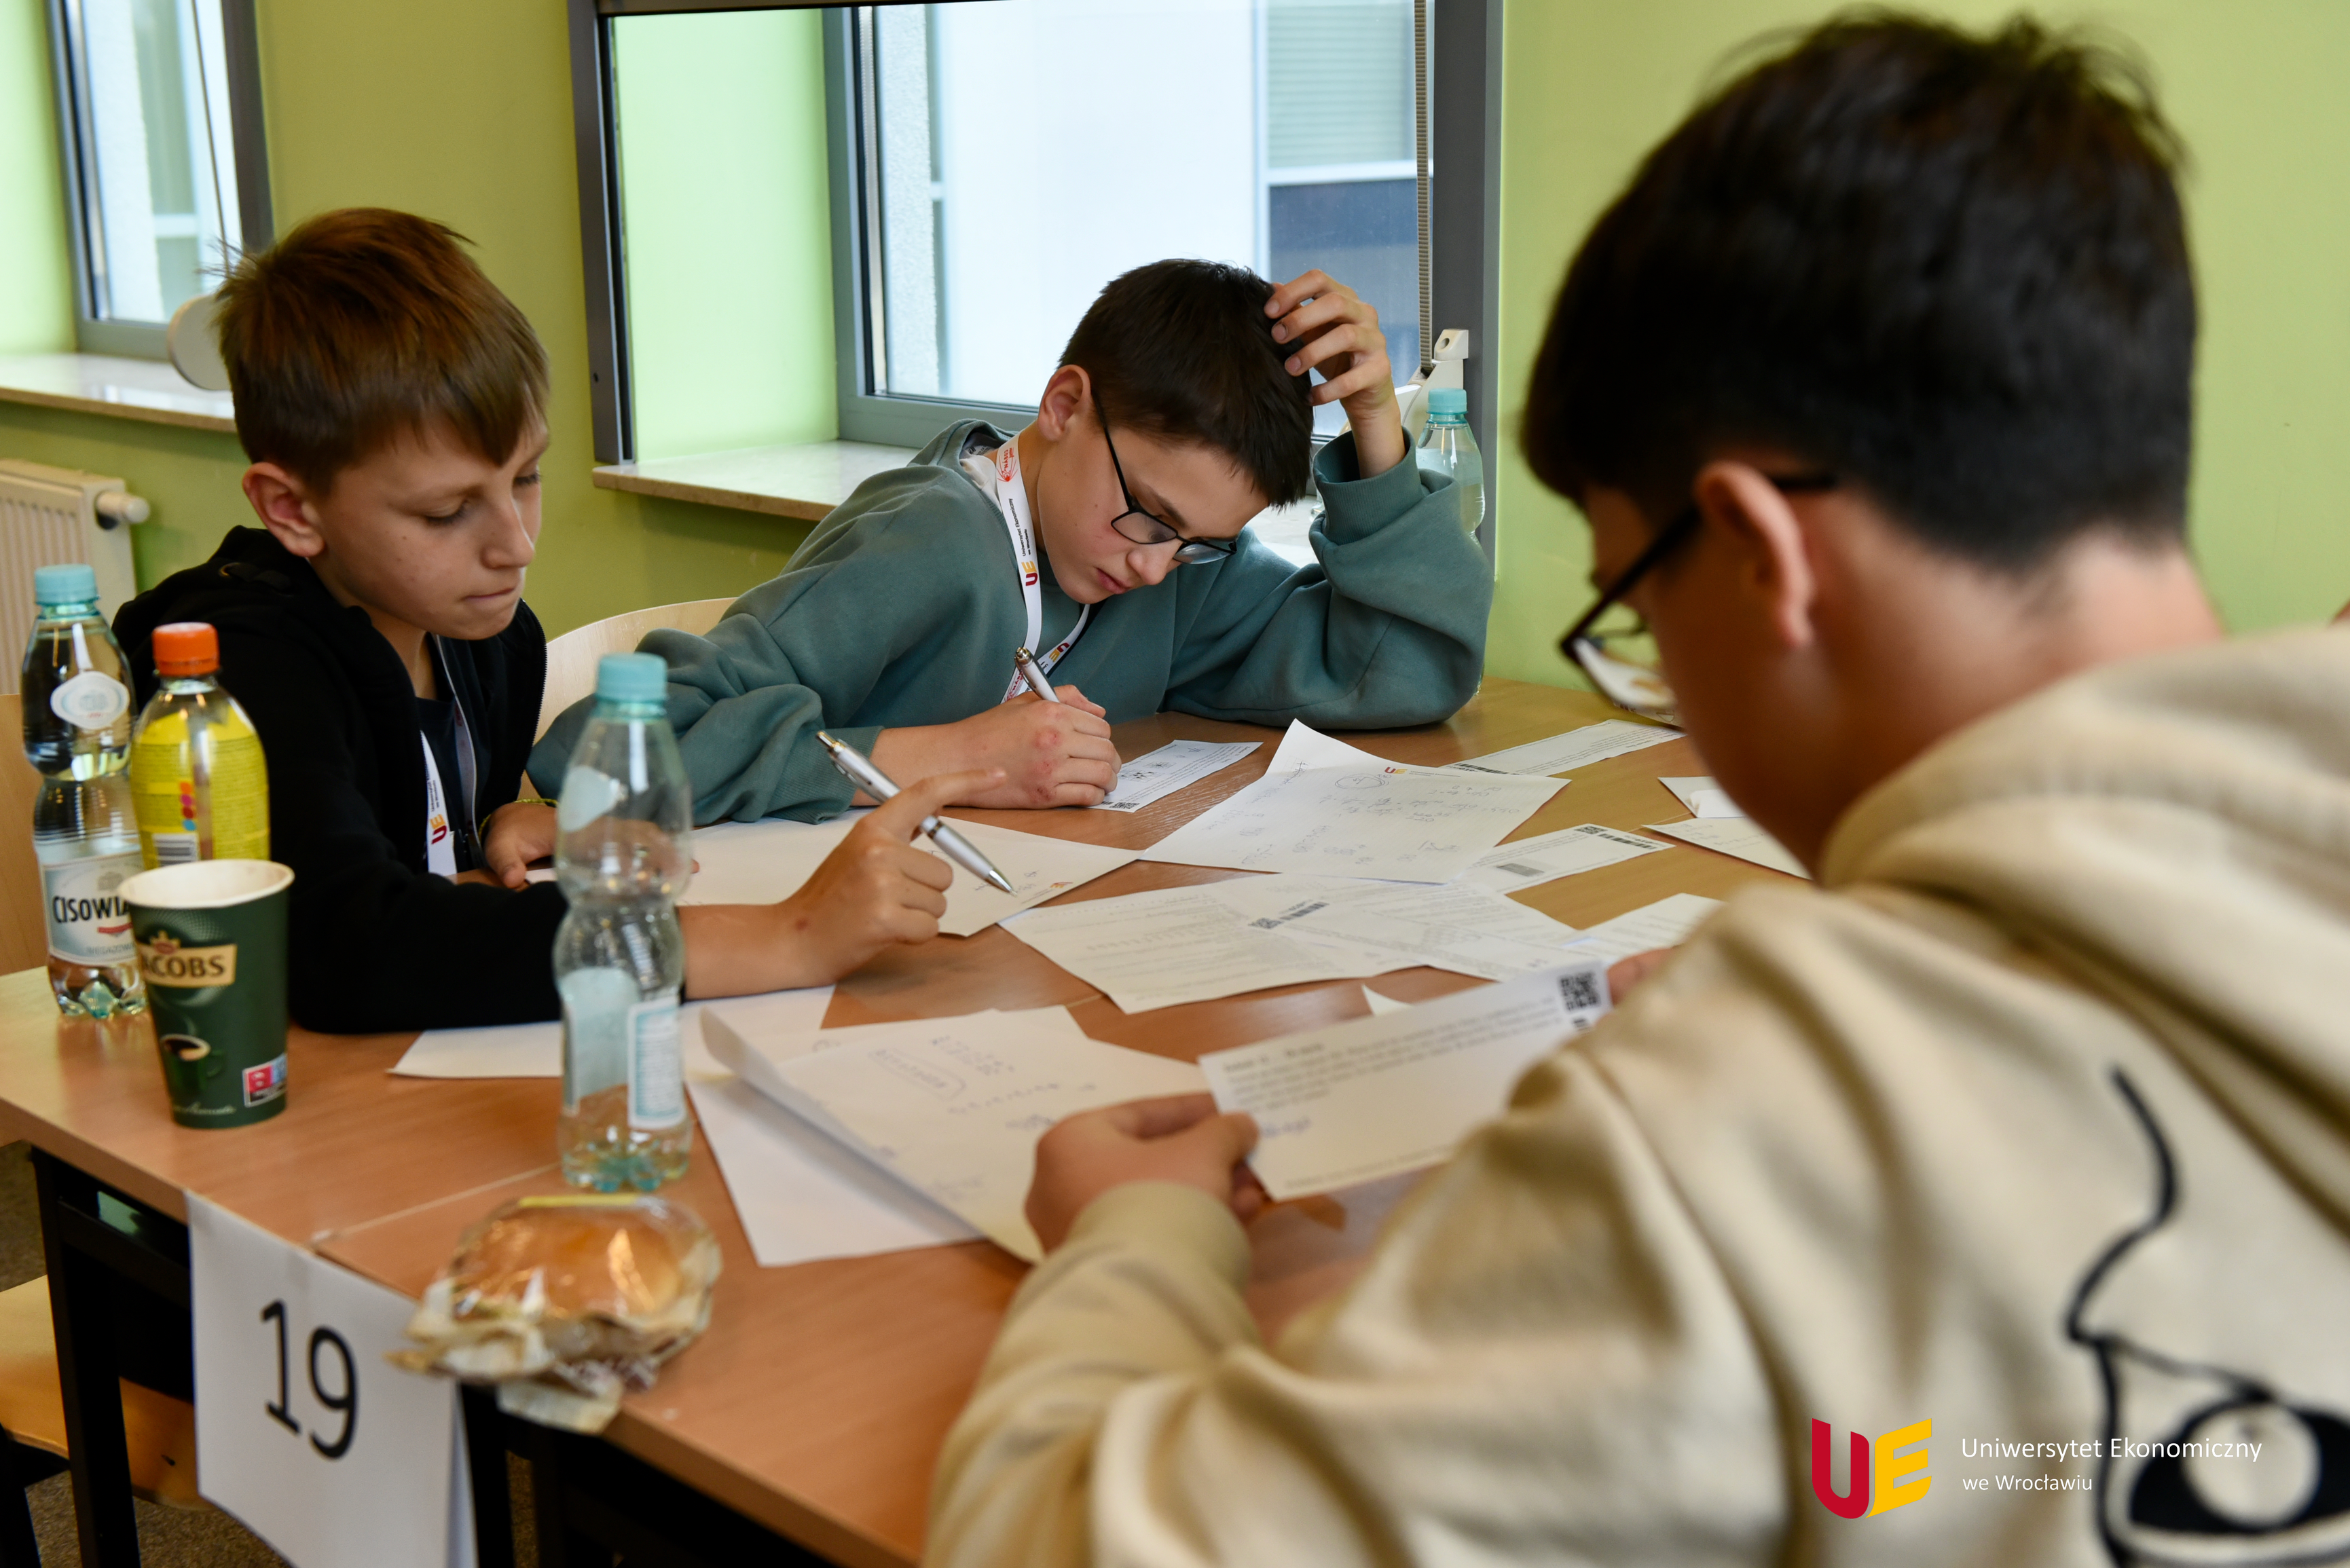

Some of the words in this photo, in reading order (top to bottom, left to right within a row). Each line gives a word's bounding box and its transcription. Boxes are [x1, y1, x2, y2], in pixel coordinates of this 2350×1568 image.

[1008, 498, 1020, 528] Ekonomiczny
[1018, 528, 1027, 557] Uniwersytet
[1021, 561, 1038, 586] UE
[430, 813, 447, 844] UE
[261, 1297, 359, 1462] 19
